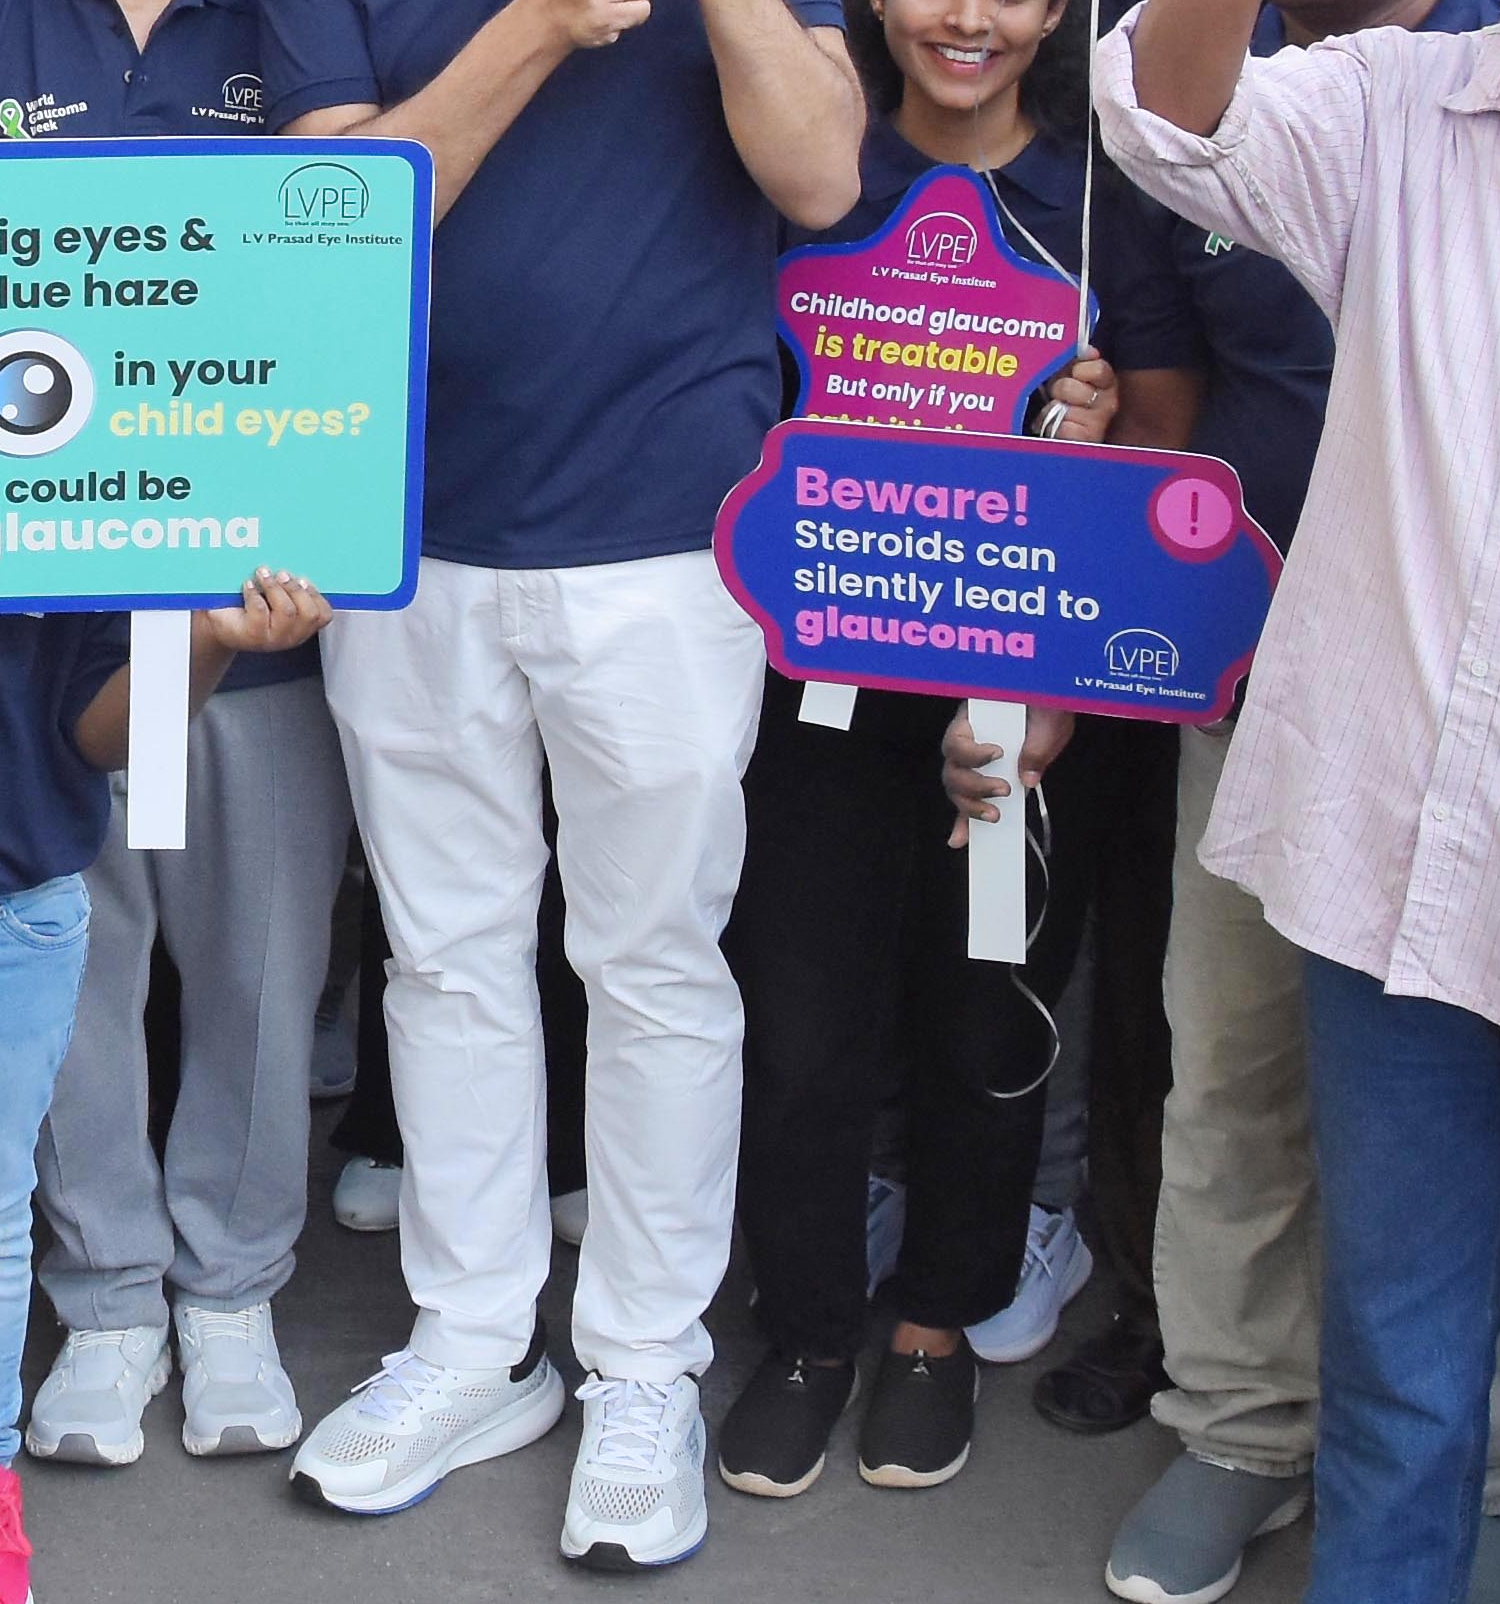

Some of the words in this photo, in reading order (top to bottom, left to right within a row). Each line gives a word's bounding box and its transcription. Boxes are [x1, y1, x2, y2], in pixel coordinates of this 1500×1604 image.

[208, 108, 239, 121] Prasad
[240, 113, 257, 124] Eye
[284, 187, 366, 219] LVPEI
[53, 222, 168, 265] eyes
[179, 217, 217, 253] &
[242, 233, 251, 244] L
[253, 233, 264, 244] V
[268, 233, 313, 244] Prasad
[317, 234, 341, 246] Eye
[345, 233, 403, 245] Institute
[908, 230, 975, 263] LVPEI
[83, 272, 199, 308] haze
[872, 266, 879, 276] L
[881, 267, 889, 277] V
[891, 268, 928, 282] Prasad
[930, 272, 949, 285] Eye
[951, 275, 997, 288] Institute
[790, 292, 926, 326] Childhood
[928, 307, 1065, 341] glaucoma
[814, 324, 844, 359] is
[852, 332, 1019, 377] treatable
[113, 350, 156, 387] in
[167, 357, 277, 397] your
[826, 374, 868, 397] But
[871, 381, 925, 410] only
[927, 384, 946, 407] if
[948, 391, 995, 414] you
[109, 401, 225, 437] child
[236, 401, 371, 447] eyes?
[4, 470, 126, 503] could
[138, 470, 192, 501] be
[796, 466, 1029, 527] Beware!
[795, 519, 965, 564] Steroids
[976, 542, 1056, 573] can
[794, 561, 944, 614] silently
[954, 576, 1046, 616] lead
[1057, 589, 1100, 622] to
[795, 605, 1036, 660] glaucoma
[1109, 645, 1175, 676] LVPEI
[1075, 677, 1083, 686] L
[1083, 678, 1093, 687] V
[1095, 679, 1133, 692] Prasad
[1136, 683, 1156, 695] Eye
[1159, 686, 1206, 700] Institute
